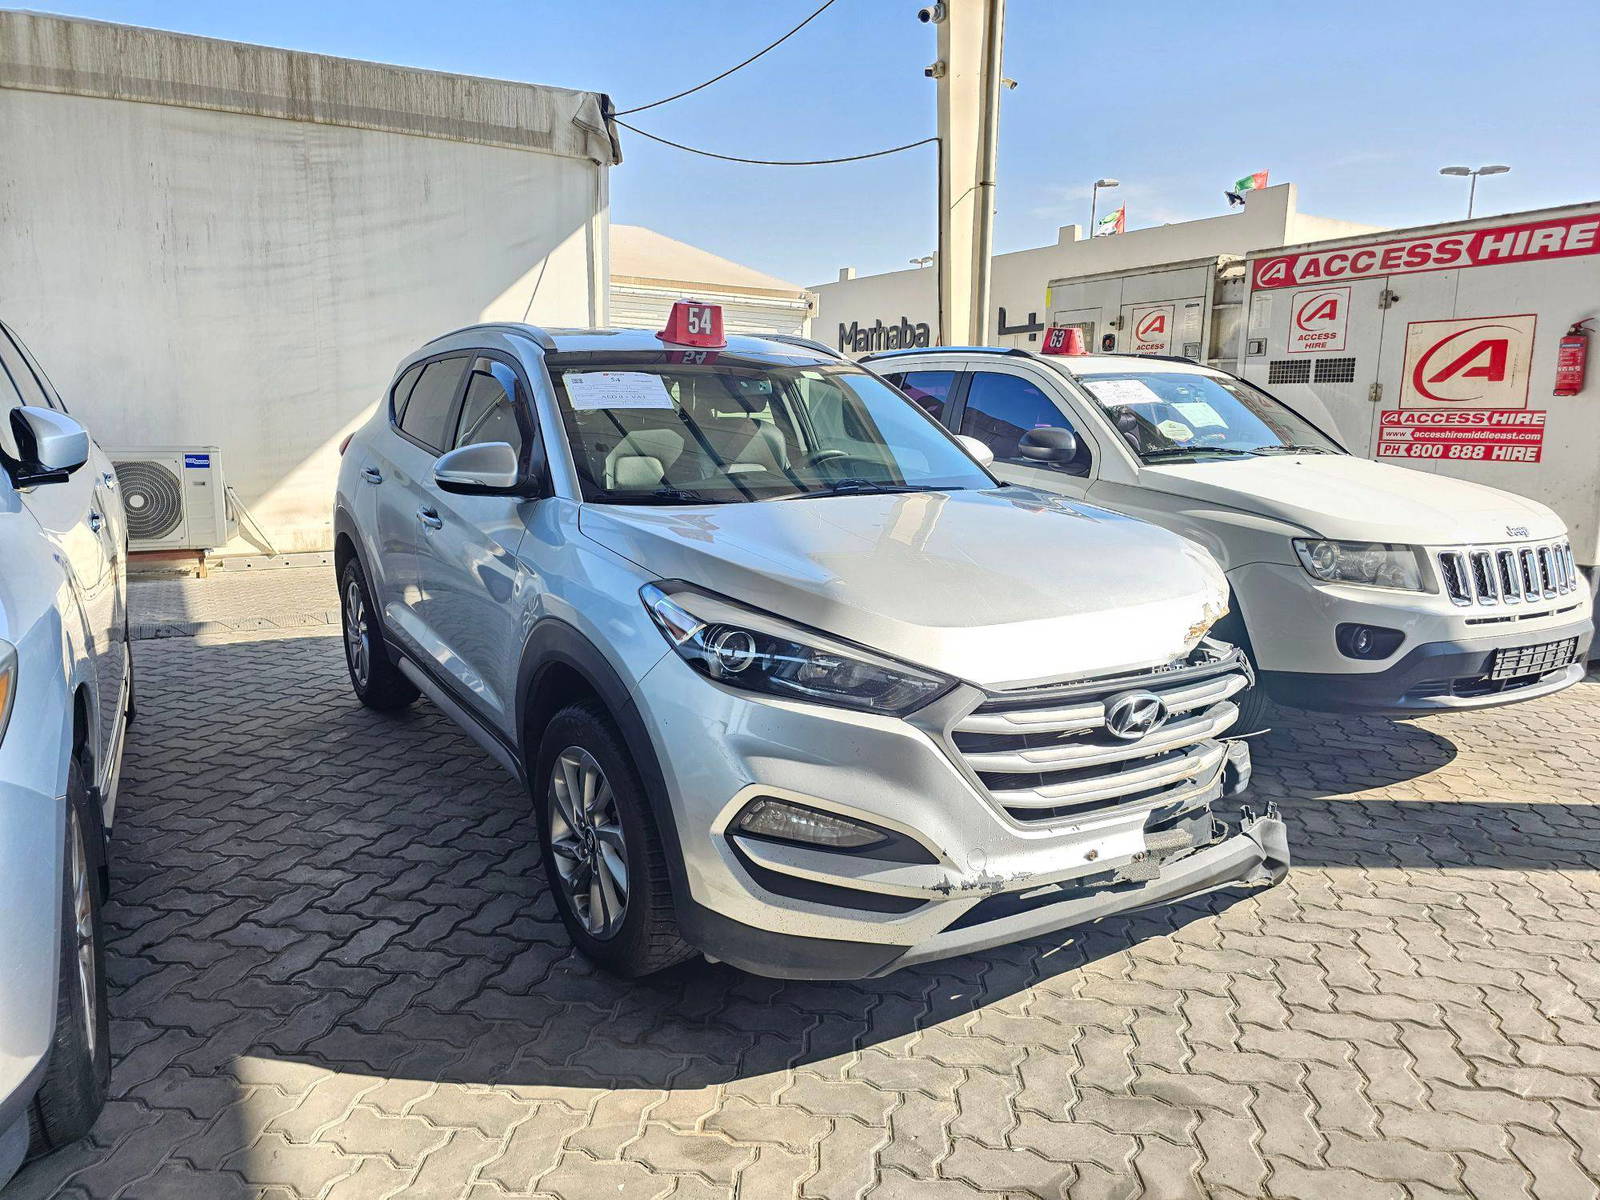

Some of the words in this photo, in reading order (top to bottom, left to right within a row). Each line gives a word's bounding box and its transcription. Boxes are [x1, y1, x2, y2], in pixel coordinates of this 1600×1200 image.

[1299, 239, 1464, 280] ACCESS
[1478, 221, 1600, 260] HIRE
[688, 307, 712, 335] 54
[839, 316, 930, 353] Marhaba
[1049, 329, 1065, 348] 63
[1297, 332, 1337, 341] ACCESS
[1136, 343, 1165, 351] ACCESS
[1304, 341, 1328, 349] HIRE
[1401, 412, 1486, 424] ACCESS
[1491, 413, 1546, 425] HIRE
[1385, 430, 1407, 438] www
[1413, 430, 1541, 441] accesshiremiddleeast.com
[1384, 444, 1403, 456] PH
[1410, 444, 1444, 458] 800
[1448, 445, 1486, 459] 888
[1491, 446, 1539, 461] HIRE
